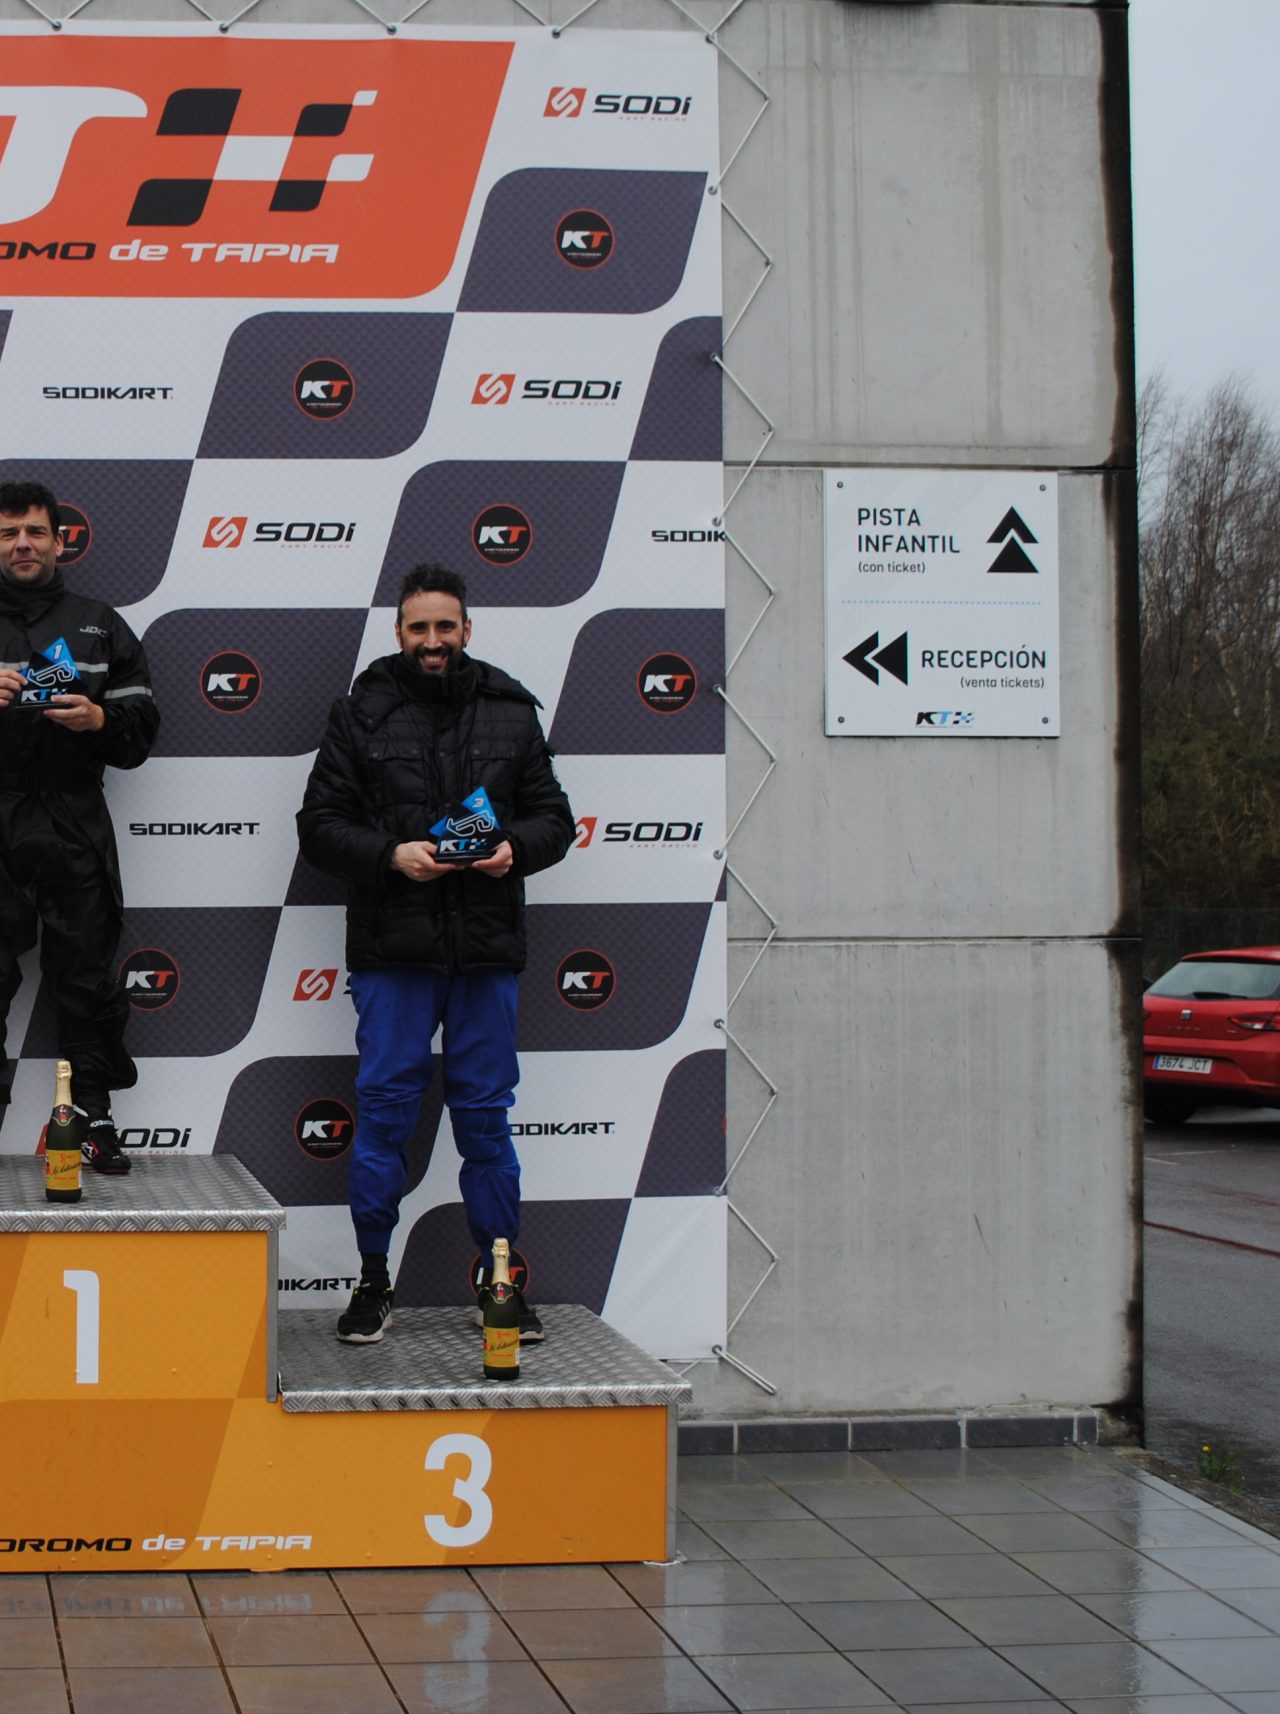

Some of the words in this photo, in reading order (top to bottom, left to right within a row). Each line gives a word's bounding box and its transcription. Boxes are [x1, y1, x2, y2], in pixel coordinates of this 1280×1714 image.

[561, 230, 608, 249] KT
[109, 239, 168, 262] de
[181, 243, 339, 264] TAPIA
[42, 386, 174, 400] SODIKART
[300, 380, 349, 399] KT
[858, 508, 921, 527] PISTA
[68, 525, 87, 542] T
[478, 526, 527, 545] KT
[858, 534, 960, 554] INFANTIL
[858, 561, 884, 574] (con
[887, 561, 926, 574] ticket)
[53, 644, 63, 660] 1
[921, 644, 1046, 669] RECEPCIÓN
[207, 673, 256, 692] KT
[643, 674, 692, 693] KT
[960, 676, 997, 689] (venta
[1000, 676, 1045, 689] tickets)
[472, 797, 485, 808] 3
[128, 822, 261, 837] SODIKART
[126, 970, 174, 989] KT
[562, 971, 610, 990] KT
[1187, 1059, 1209, 1071] JCT
[301, 1120, 349, 1139] KT
[63, 1270, 100, 1385] 1
[423, 1433, 494, 1548] 3
[141, 1533, 185, 1552] de
[195, 1535, 312, 1551] TAPIA
